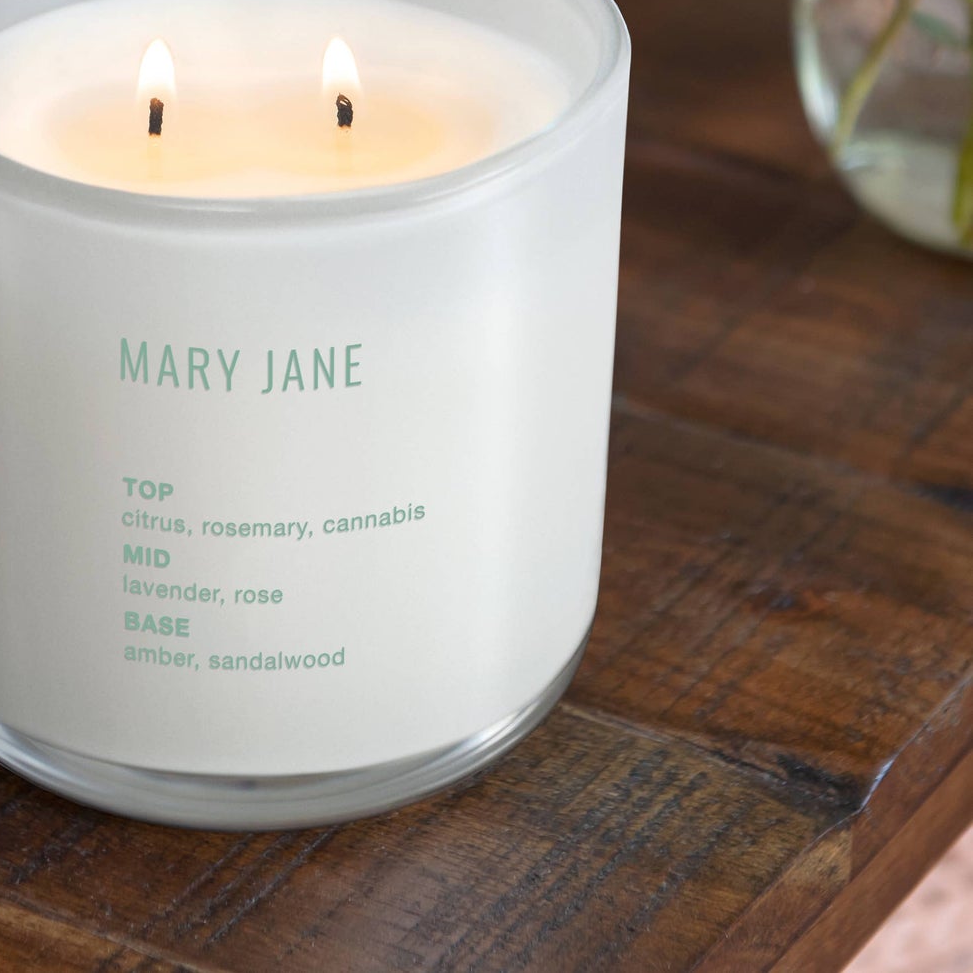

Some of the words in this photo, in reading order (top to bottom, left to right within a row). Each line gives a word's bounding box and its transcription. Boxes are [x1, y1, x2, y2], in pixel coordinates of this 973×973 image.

[120, 337, 241, 393] MARY
[261, 343, 363, 394] JANE
[122, 477, 175, 502] TOP
[122, 509, 193, 536] citrus,
[202, 517, 314, 540] rosemary,
[322, 502, 426, 534] cannabis
[123, 543, 171, 568] MID
[123, 574, 225, 606] lavender,
[234, 587, 284, 605] rose
[124, 611, 191, 638] BASE
[124, 644, 200, 671] amber,
[208, 647, 346, 671] sandalwood
